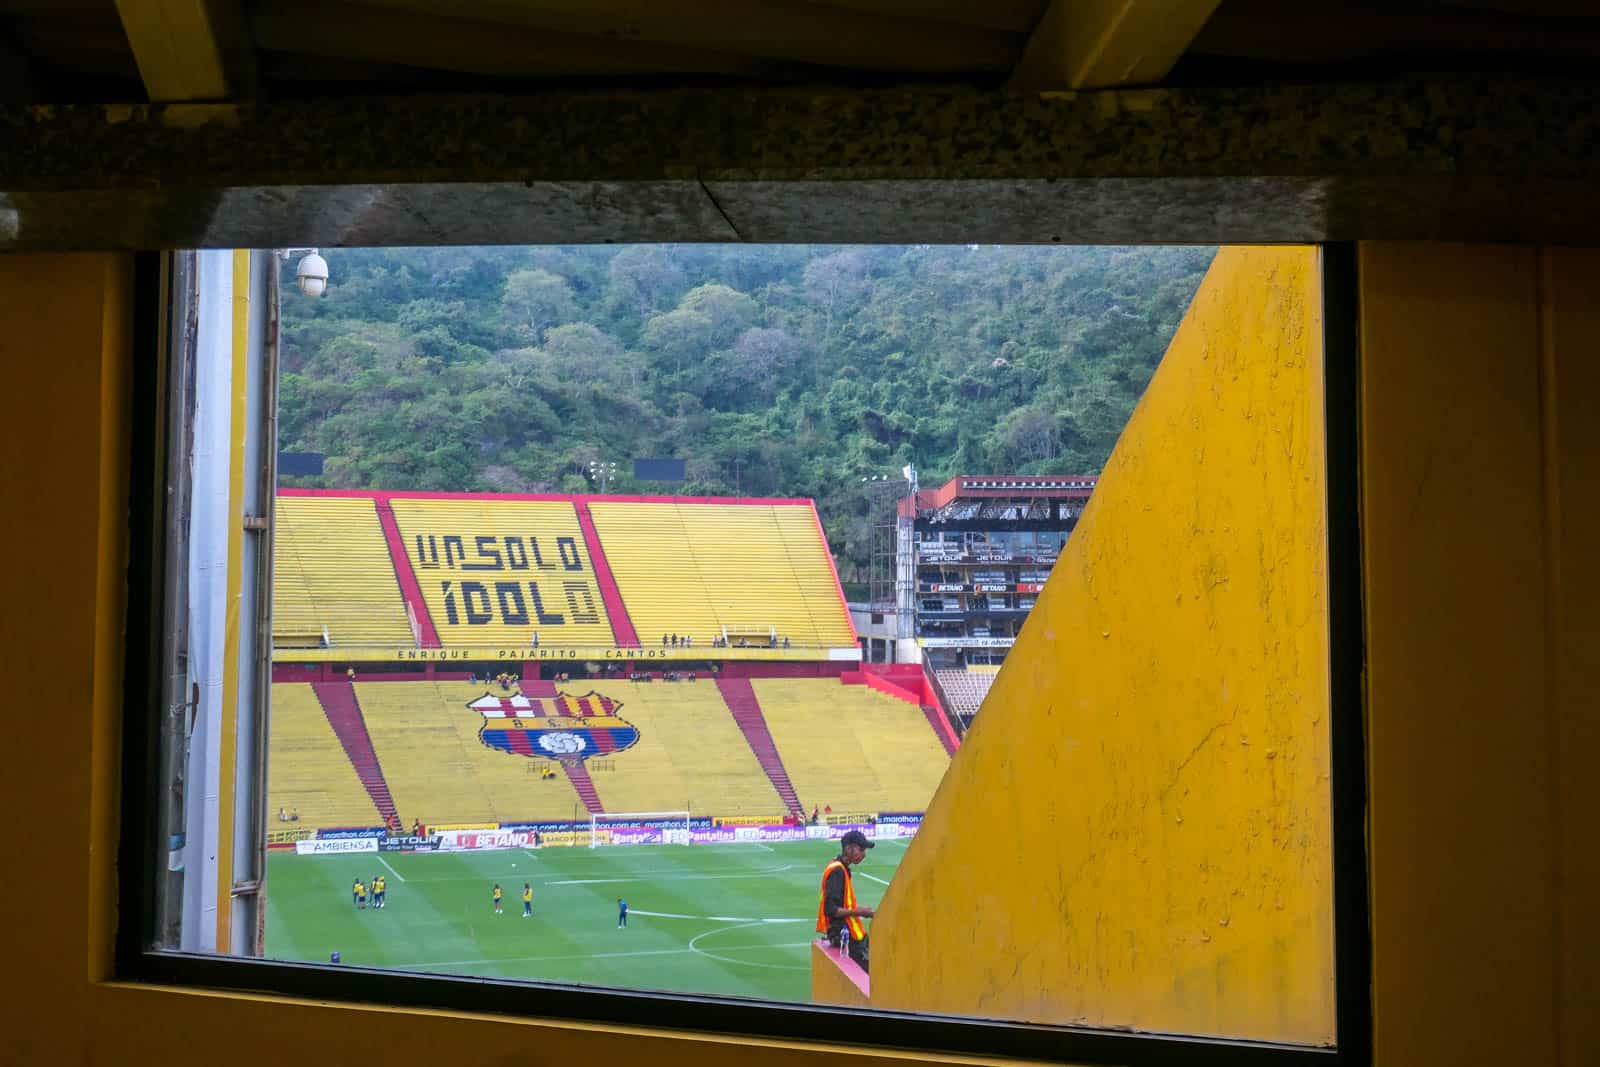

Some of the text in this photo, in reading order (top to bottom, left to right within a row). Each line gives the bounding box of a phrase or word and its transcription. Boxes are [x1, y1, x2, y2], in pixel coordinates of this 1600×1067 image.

[461, 536, 583, 571] SOLO
[398, 649, 667, 660] ENRIQUE PAJARITO CANTOS
[380, 836, 438, 845] JETOUR
[477, 832, 528, 847] BETANO
[689, 830, 734, 841] Pantallas
[760, 828, 805, 840] Pantallas
[314, 842, 373, 851] AMBIENSA
